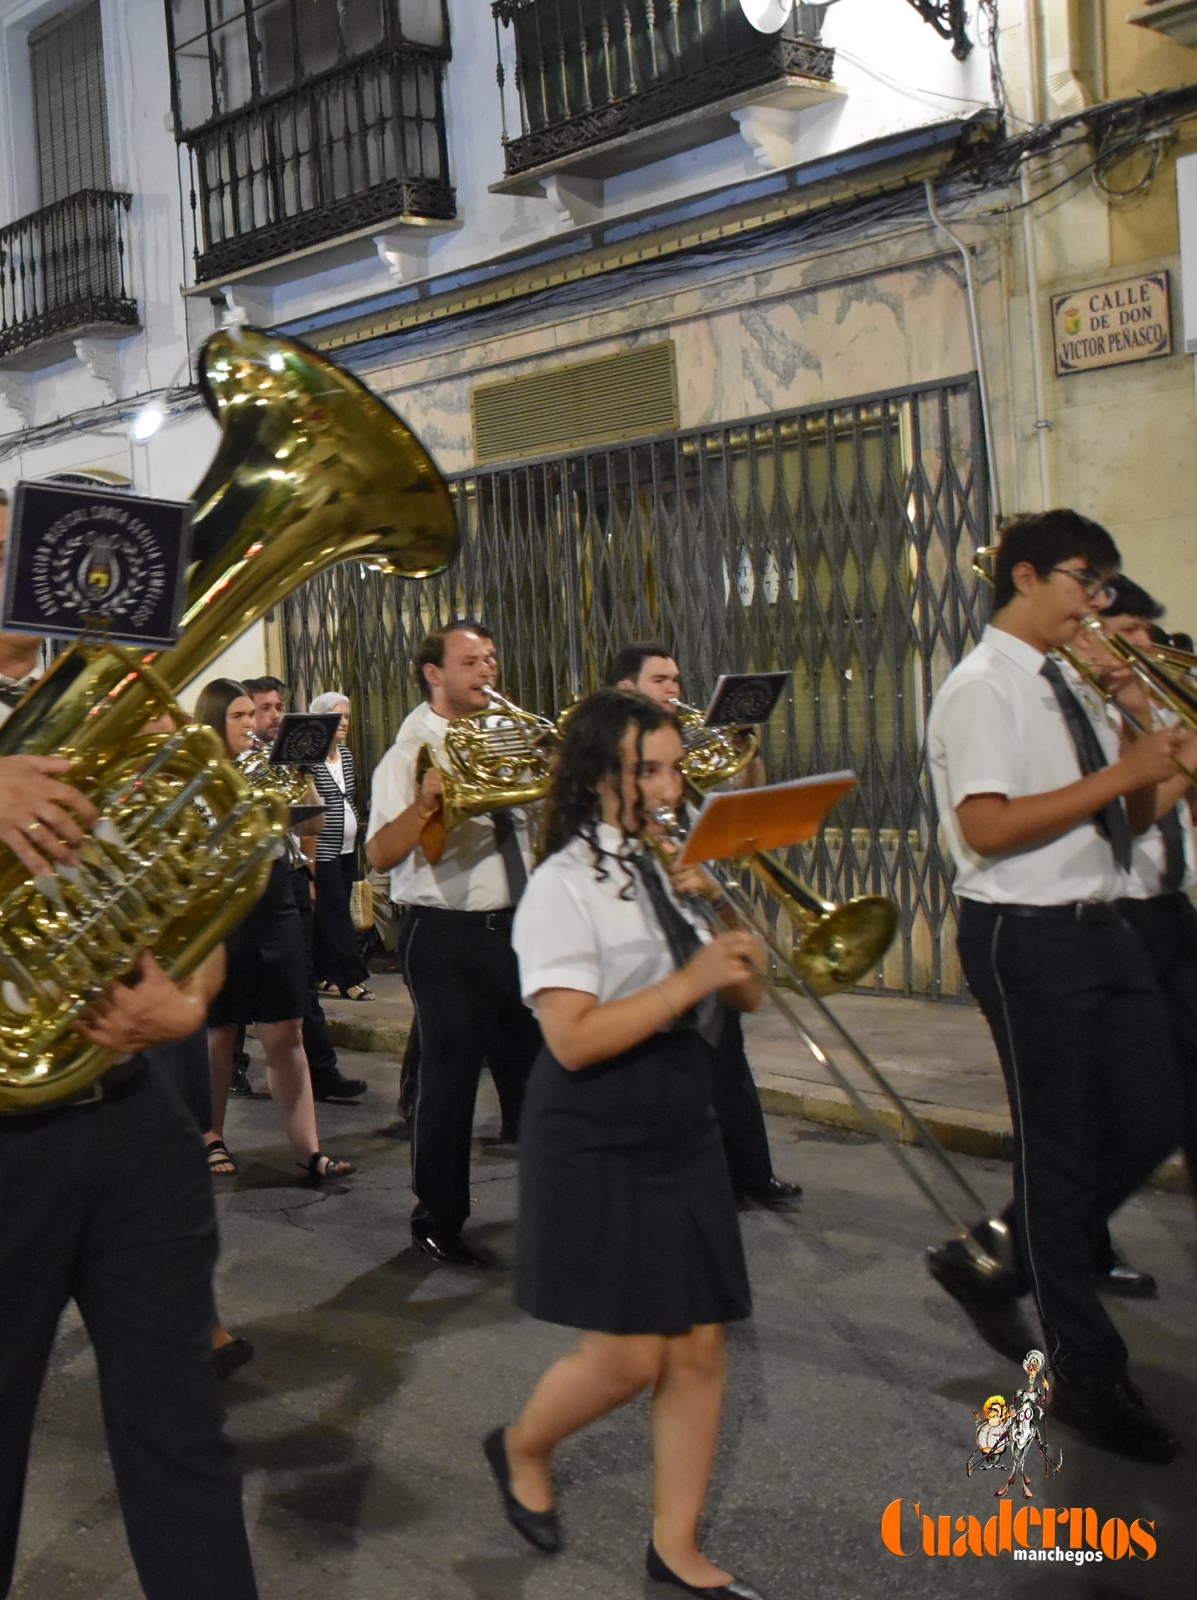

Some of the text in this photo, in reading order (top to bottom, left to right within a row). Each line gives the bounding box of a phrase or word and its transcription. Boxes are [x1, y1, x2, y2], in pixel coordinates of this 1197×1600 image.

[1089, 284, 1151, 313] CALLE
[1090, 305, 1152, 331] DE DON
[1062, 323, 1163, 362] VICTOR PEÑASCO
